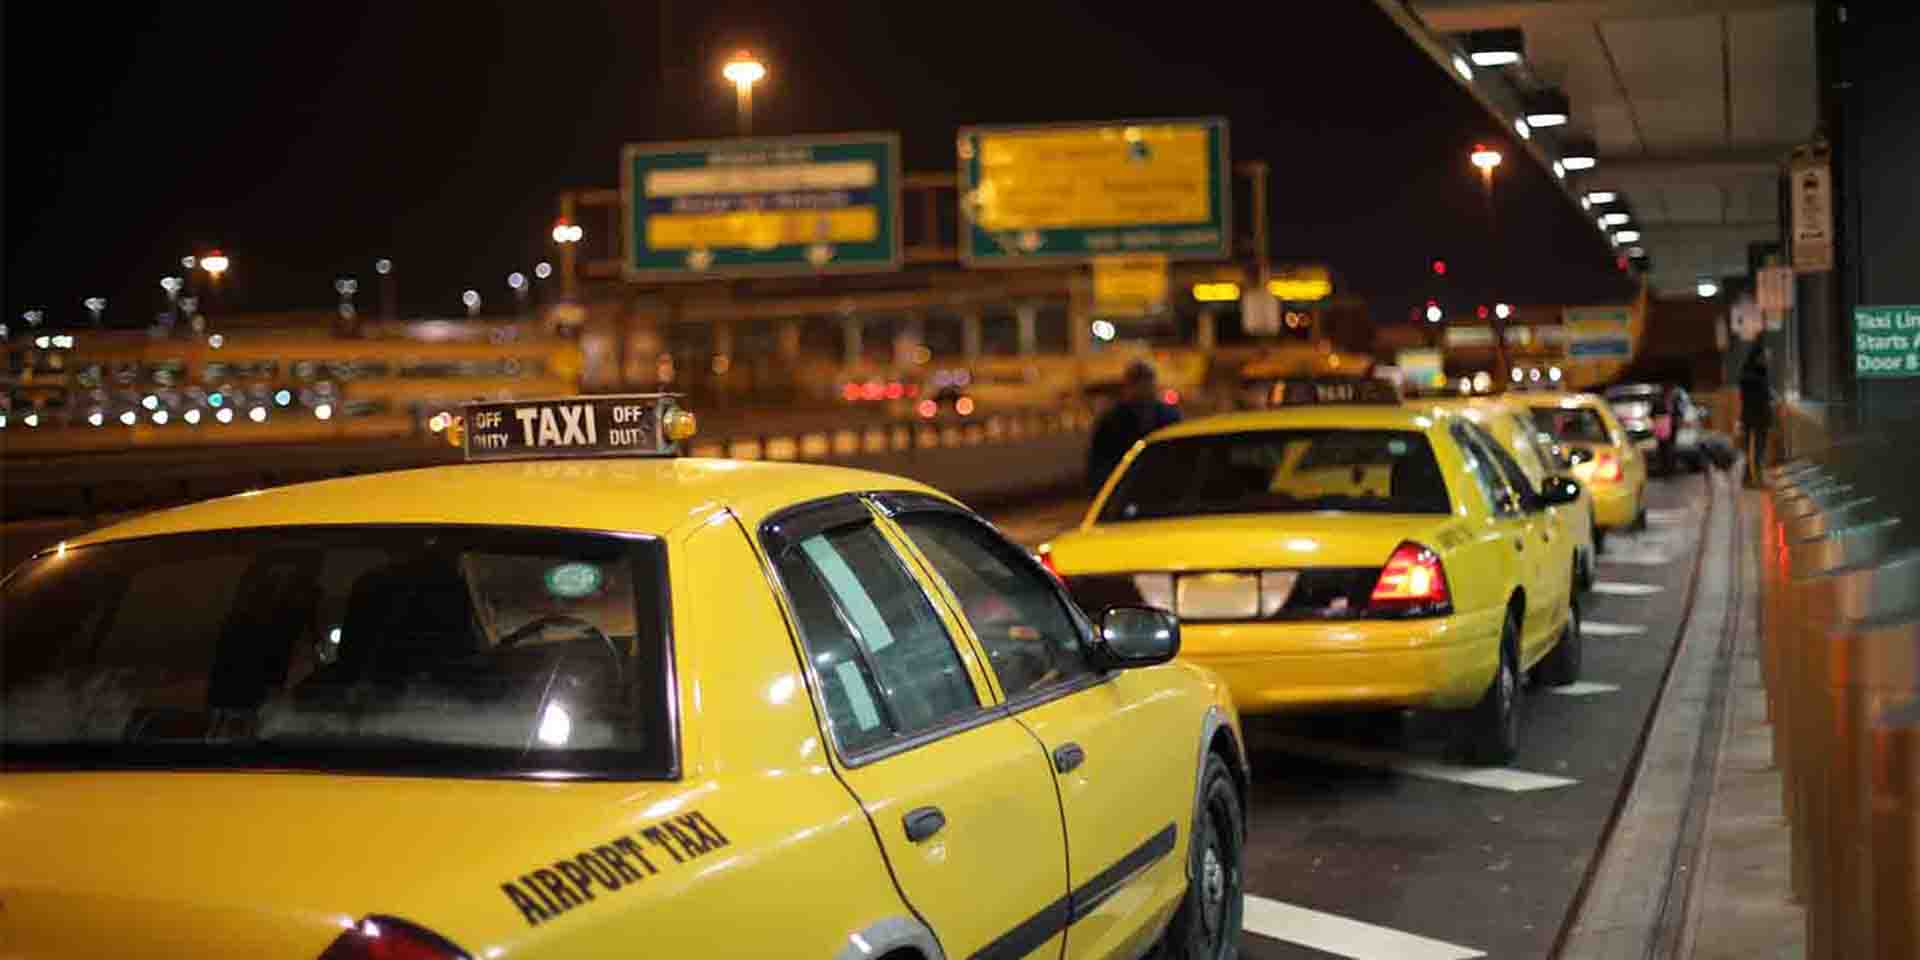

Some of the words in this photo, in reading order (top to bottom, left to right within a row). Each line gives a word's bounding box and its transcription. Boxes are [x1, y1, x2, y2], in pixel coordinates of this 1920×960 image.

[1855, 312, 1891, 329] Taxi
[1856, 333, 1909, 351] Starts
[1856, 352, 1904, 371] Door
[475, 411, 503, 429] OFF
[613, 406, 643, 423] OFF
[516, 404, 598, 447] TAXI
[501, 835, 658, 927] AIRPORT
[640, 810, 730, 864] TAXI
